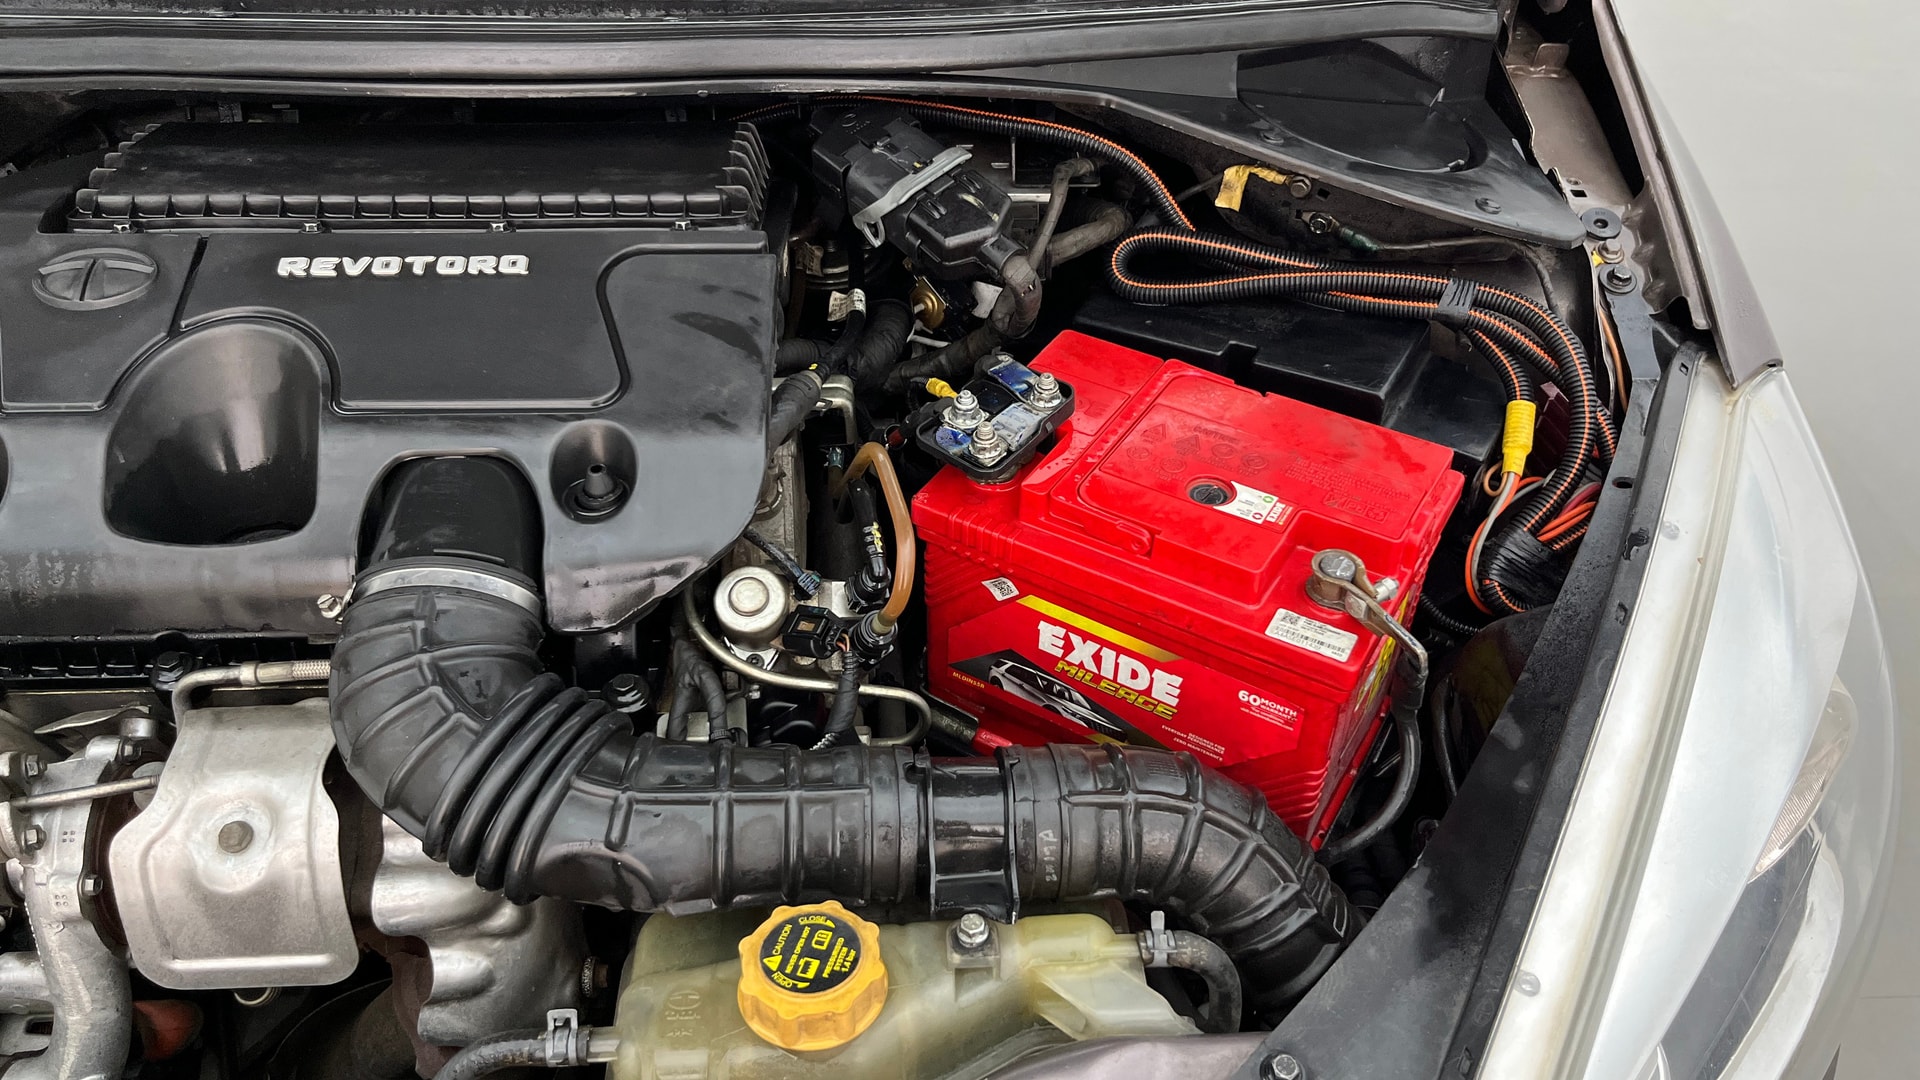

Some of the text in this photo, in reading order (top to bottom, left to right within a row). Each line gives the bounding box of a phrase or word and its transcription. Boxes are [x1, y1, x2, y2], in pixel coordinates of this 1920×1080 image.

[277, 254, 529, 277] REVOTORQ
[1037, 620, 1184, 707] EXIDE
[1055, 661, 1178, 720] MILEAGE
[1238, 690, 1261, 706] 60
[1260, 697, 1298, 717] MONTH
[1161, 724, 1187, 738] EVERYDAY
[772, 923, 793, 955] CAUTION
[771, 971, 793, 988] OPEN
